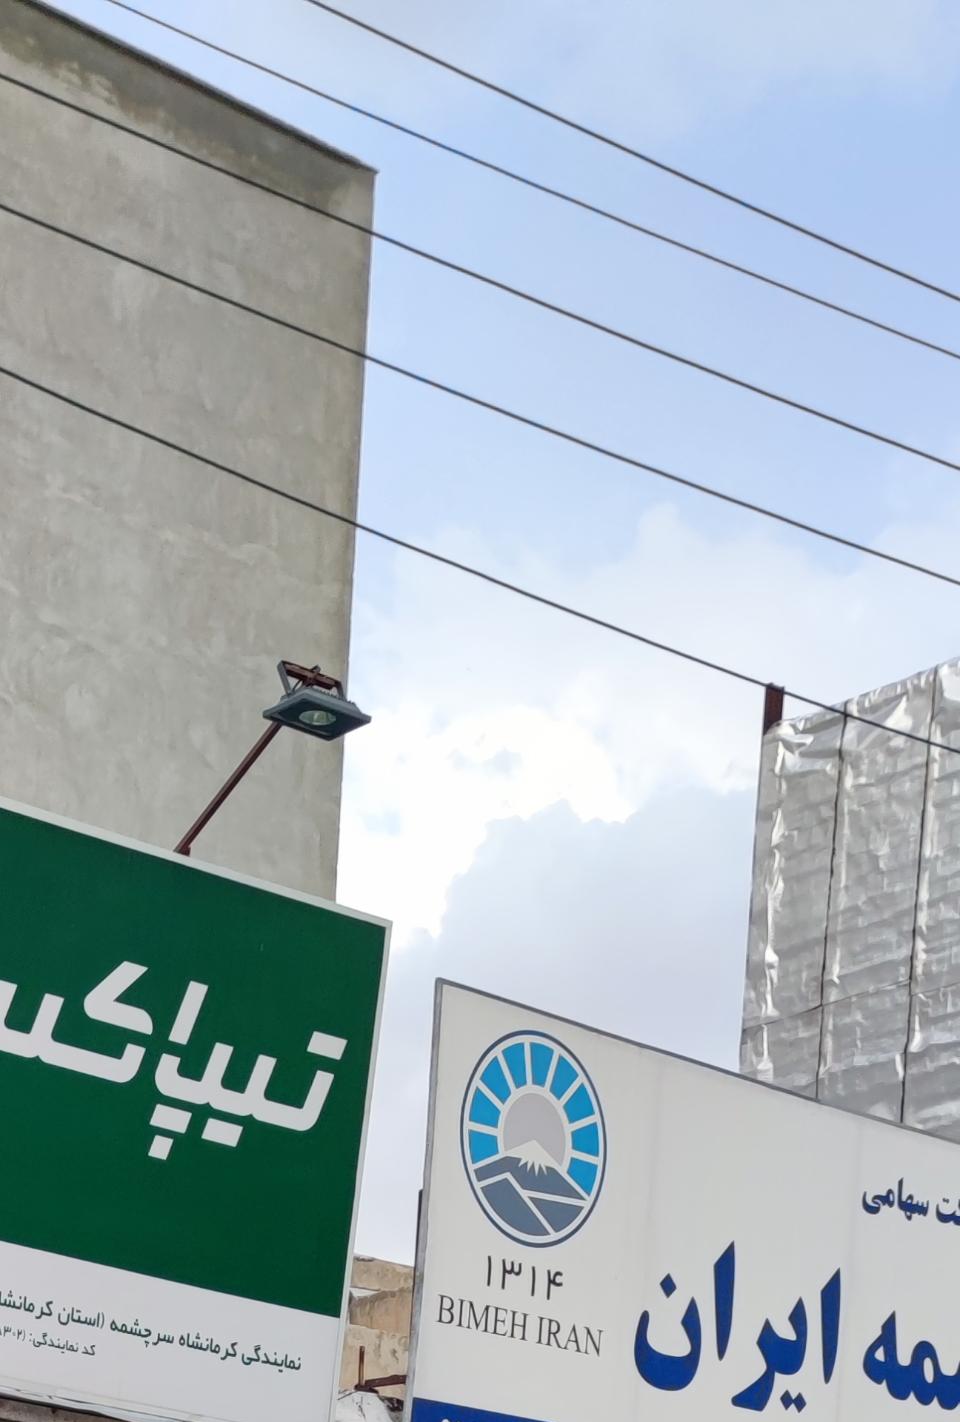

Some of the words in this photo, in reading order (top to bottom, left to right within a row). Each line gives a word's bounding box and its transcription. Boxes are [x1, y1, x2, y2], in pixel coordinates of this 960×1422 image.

[862, 1177, 930, 1222] سهامی
[486, 1255, 564, 1301] ۱۳۱۴
[57, 1306, 106, 1330] (استان
[109, 1318, 175, 1348] سرچشمه
[436, 1294, 530, 1342] BIMEH
[535, 1315, 605, 1357] IRAN
[633, 1240, 842, 1413] ایران
[29, 1331, 80, 1354] نمایندگی:
[81, 1343, 96, 1357] کد
[178, 1333, 238, 1362] کرمانشاه
[241, 1344, 302, 1374] نمایندگی
